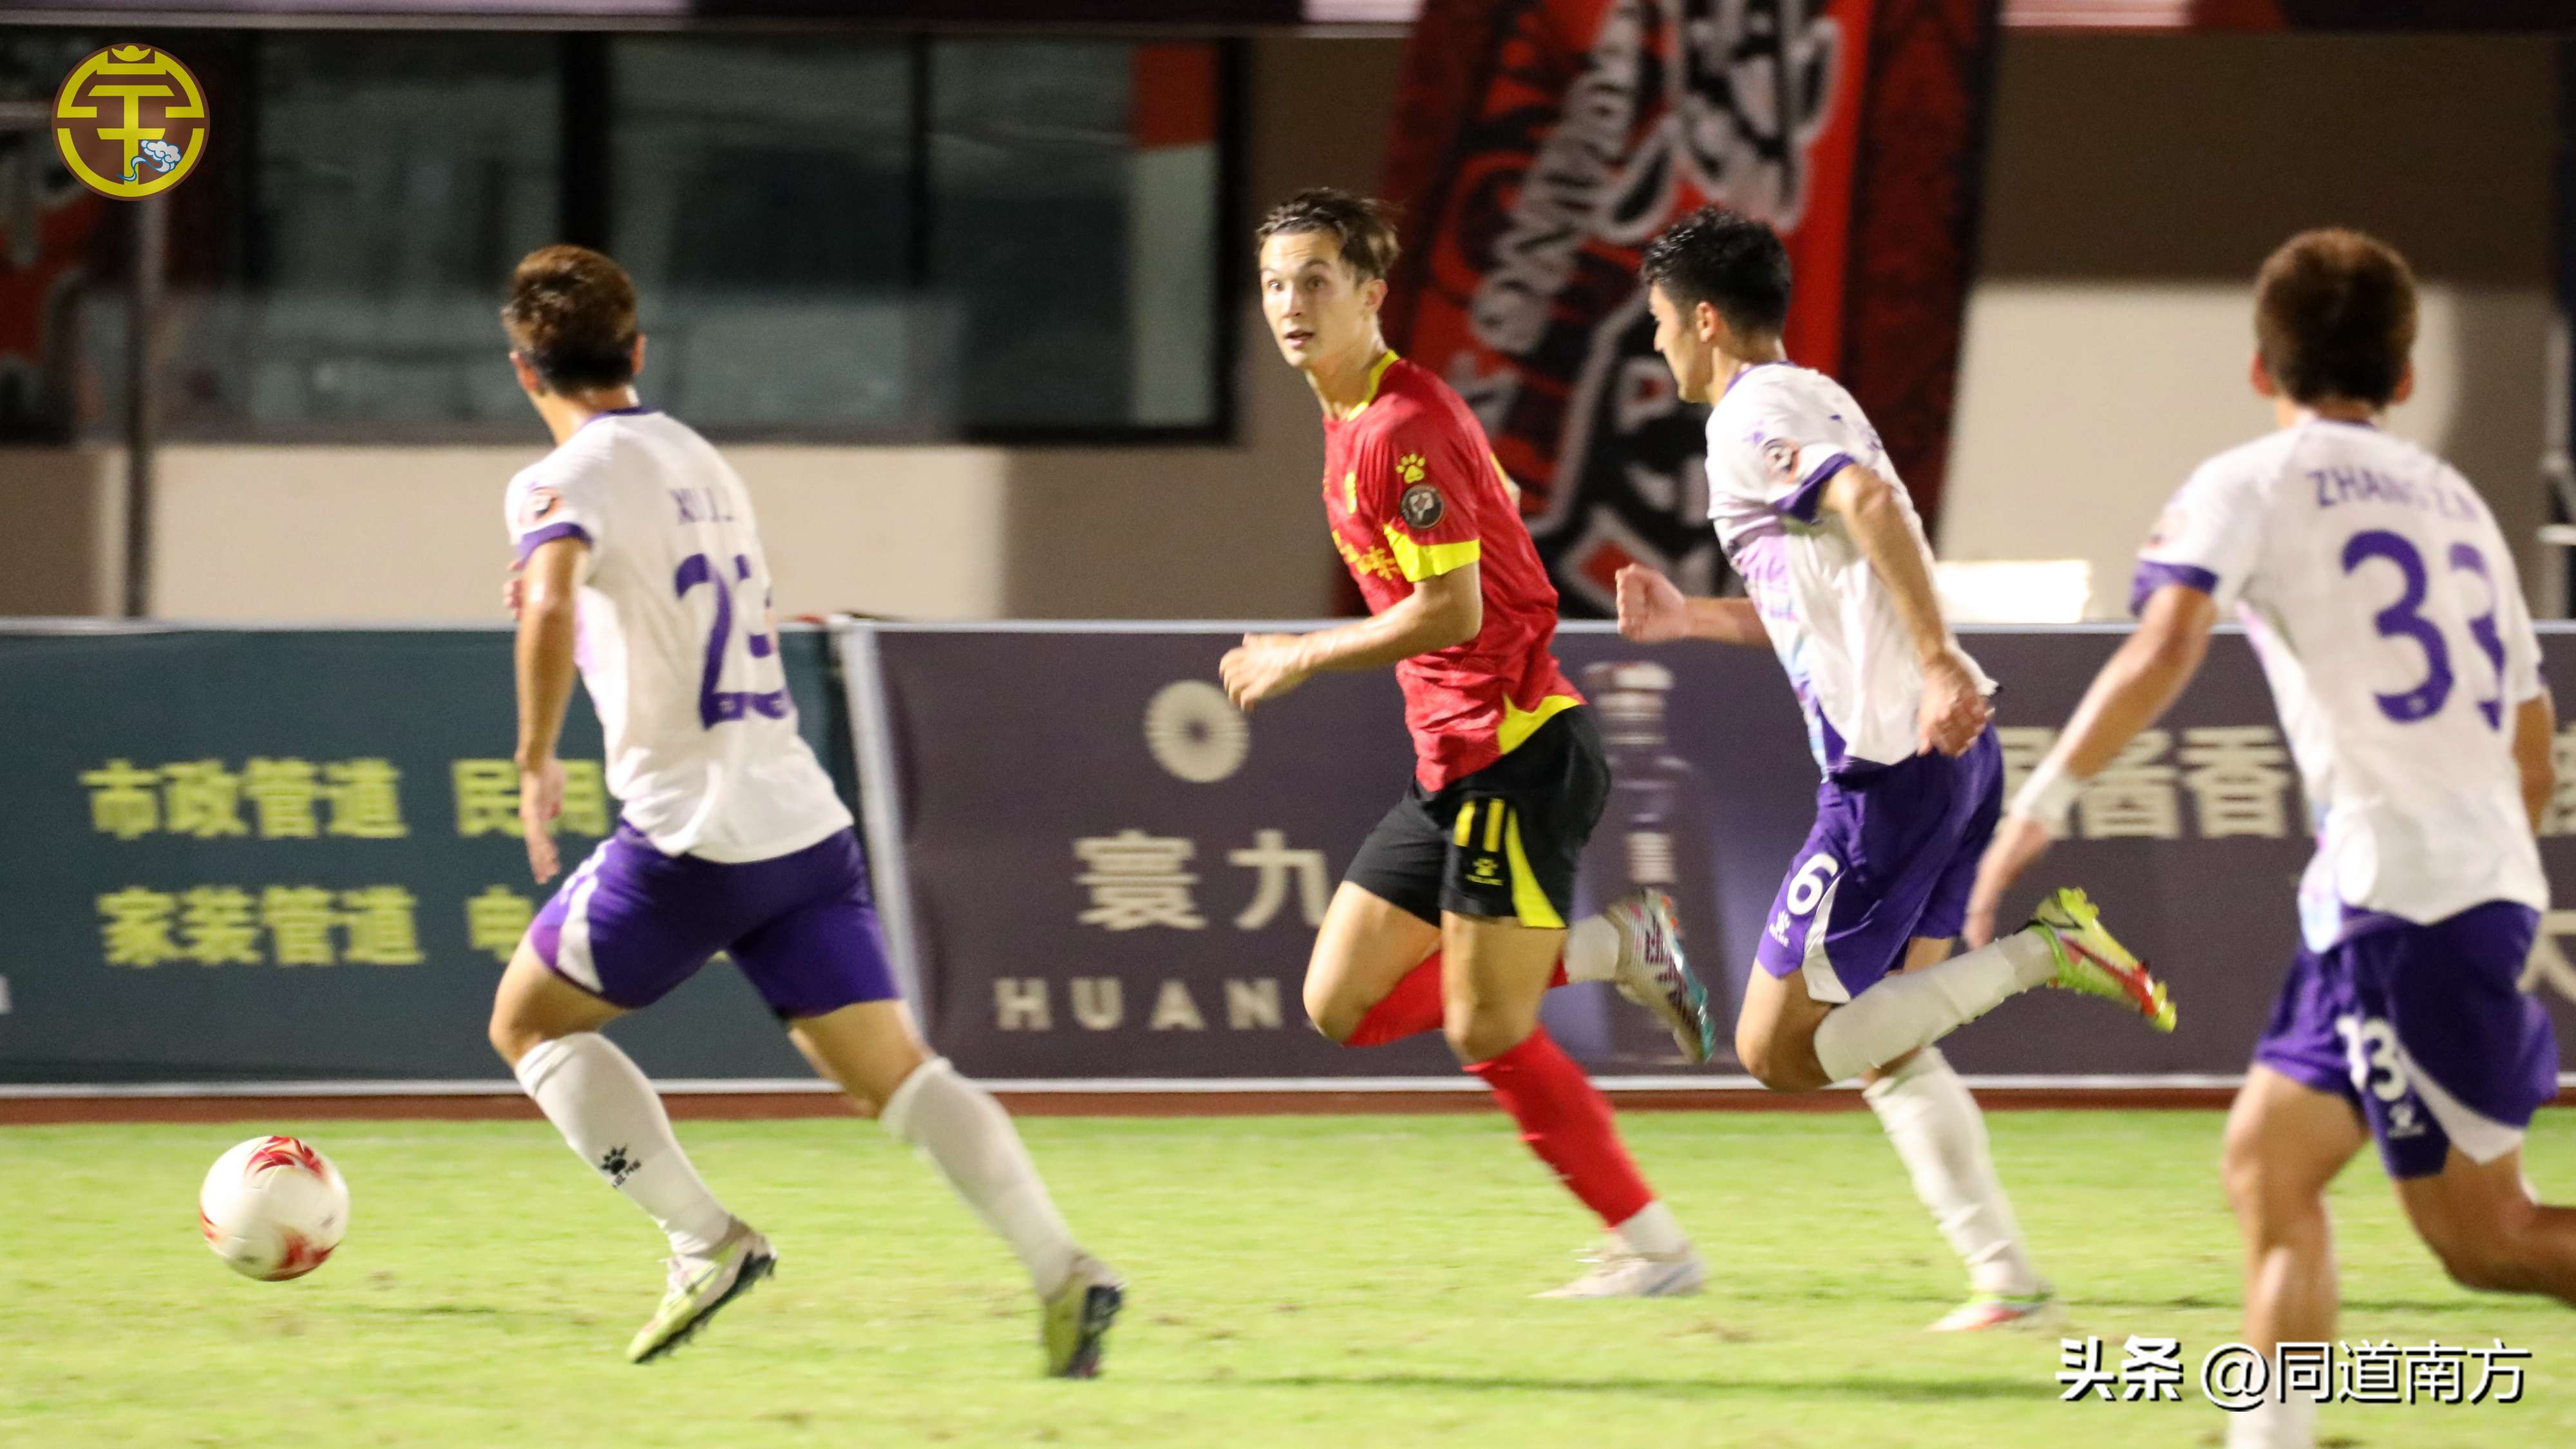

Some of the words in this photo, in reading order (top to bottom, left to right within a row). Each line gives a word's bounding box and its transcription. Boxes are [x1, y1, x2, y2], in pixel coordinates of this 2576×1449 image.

[79, 759, 408, 840] 市政管道
[1786, 853, 1839, 916] 6
[95, 885, 426, 967] 家装管道
